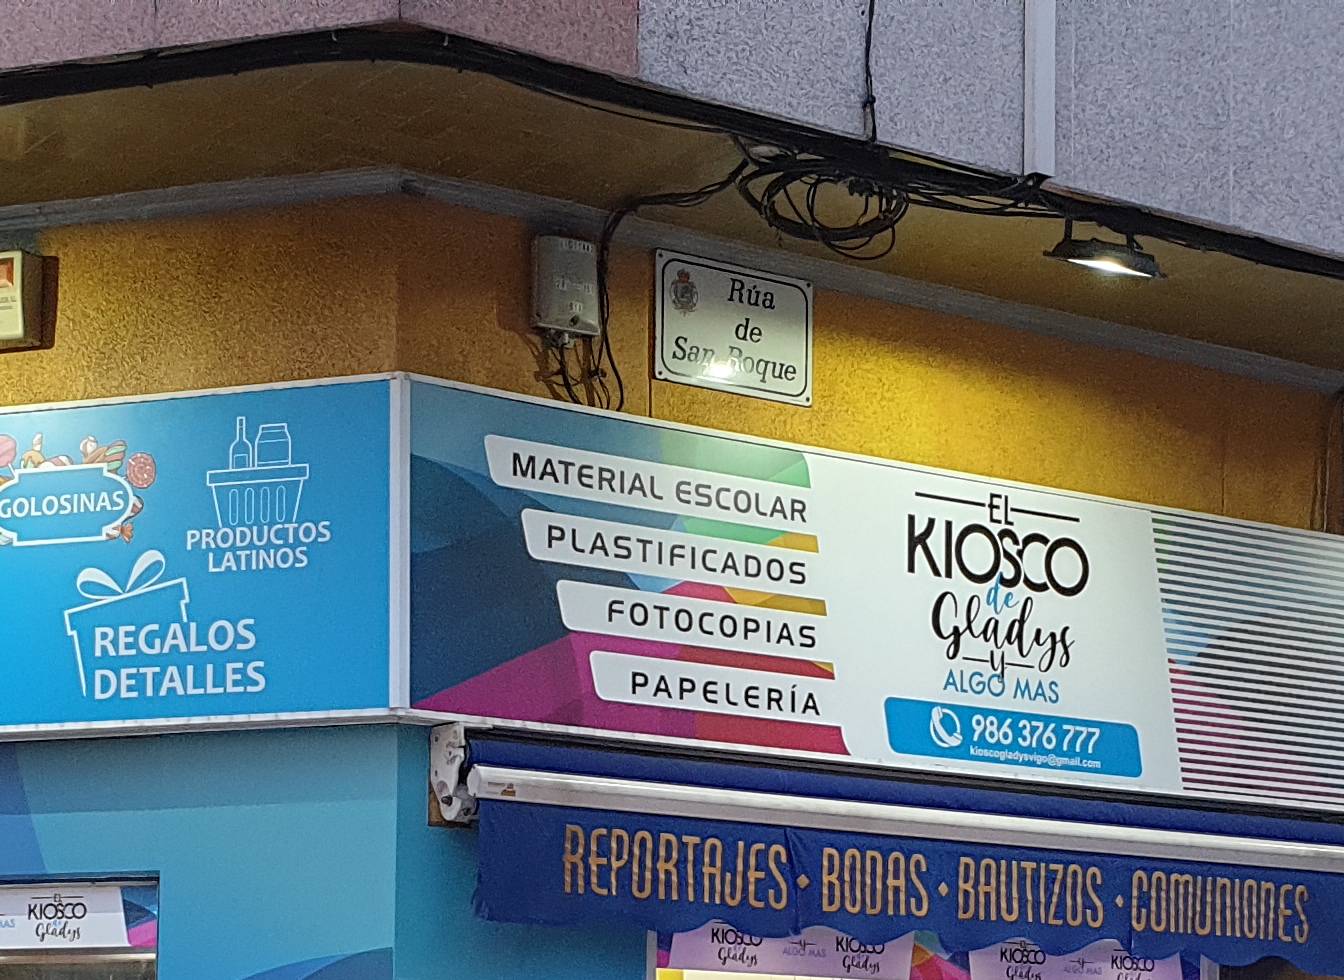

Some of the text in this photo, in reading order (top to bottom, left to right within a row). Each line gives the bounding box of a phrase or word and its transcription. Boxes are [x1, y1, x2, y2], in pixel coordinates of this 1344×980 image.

[727, 278, 776, 309] Rúa
[735, 318, 762, 343] de
[672, 336, 797, 383] San Roque
[512, 451, 808, 524] MATERIAL ESCOLAR
[988, 493, 1014, 526] EL
[186, 519, 332, 549] PRODUCTOS
[208, 546, 309, 573] LATINOS
[546, 523, 807, 586] PLASTIFICADOS
[907, 513, 1090, 598] KIOSCO
[986, 571, 1020, 616] de
[94, 618, 257, 658] REGALOS
[607, 599, 817, 650] FOTOCOPIAS
[931, 591, 1076, 674] Gladys
[94, 661, 266, 699] DETALLES
[989, 650, 1007, 684] y
[631, 670, 821, 717] PAPELERÍA
[943, 668, 1060, 704] ALGO MAS
[971, 713, 1101, 754] 986 376 777
[969, 745, 1102, 769] kioscogladysvigo@gmail.com
[562, 823, 1310, 943] REPORTAJES BODAS BAUTIZOS COMUNIONES
[27, 902, 87, 921] KIOSCO
[35, 920, 81, 943] Gladys
[717, 946, 758, 966] Gladys
[842, 954, 880, 975] Gladys
[999, 947, 1047, 965] KIOSCO
[1111, 955, 1155, 972] KIOSCO
